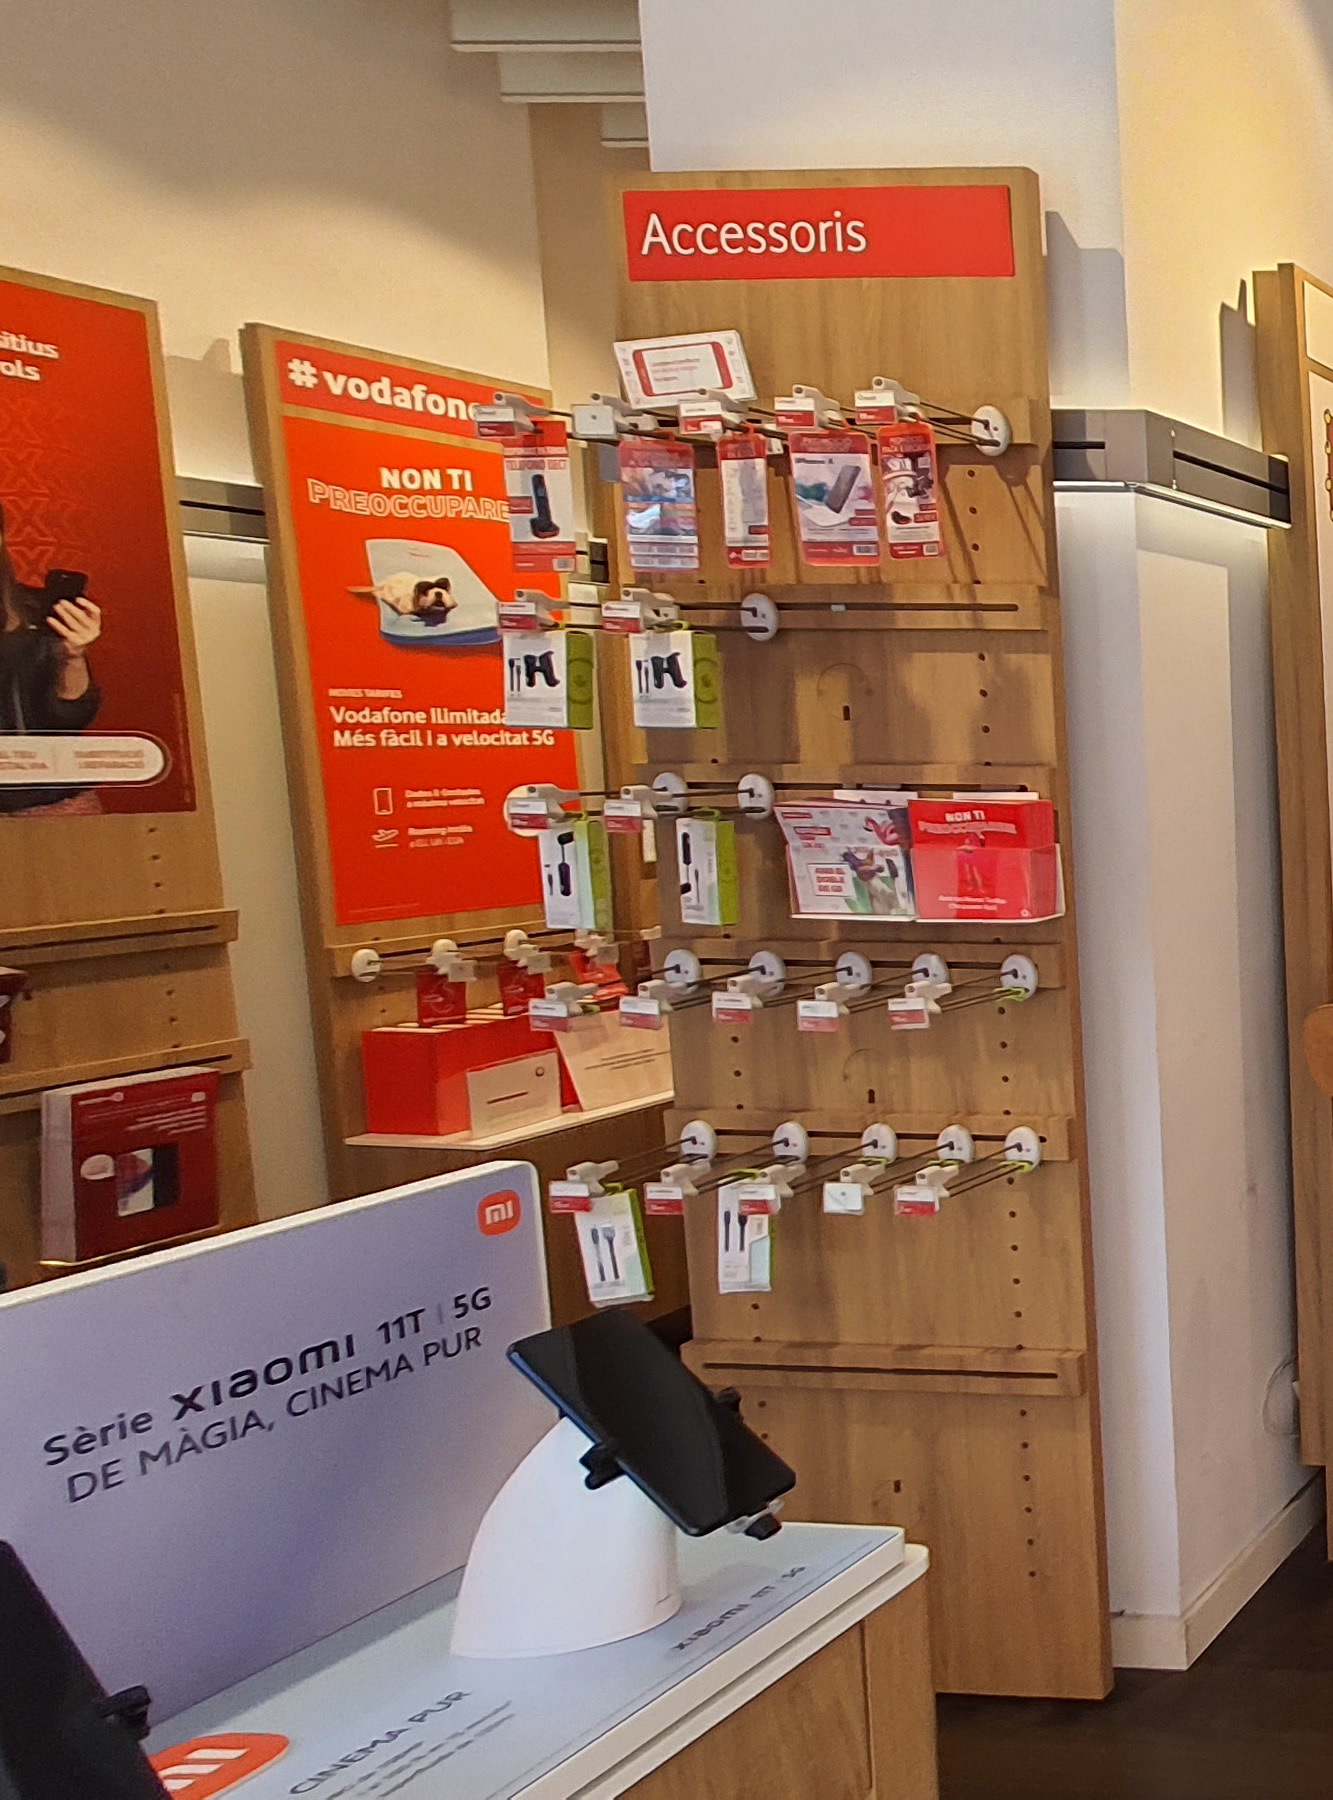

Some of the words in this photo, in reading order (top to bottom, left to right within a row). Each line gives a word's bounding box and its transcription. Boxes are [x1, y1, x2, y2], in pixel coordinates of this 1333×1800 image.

[640, 210, 867, 256] Accessoris
[380, 466, 442, 491] NON
[447, 468, 473, 492] TI
[329, 706, 427, 725] Vodafone
[333, 729, 377, 747] Més
[436, 733, 448, 747] a
[452, 729, 530, 747] velocitat
[532, 729, 555, 746] 5G
[43, 1406, 154, 1468] Sèrie
[376, 1307, 426, 1347] 11T
[453, 1286, 493, 1319] 5G
[66, 1457, 125, 1503] DE
[140, 1408, 275, 1475] MÀGIA,
[285, 1351, 414, 1419] CINEMA
[423, 1325, 482, 1368] PUR
[288, 1726, 411, 1797] CINEMA
[407, 1690, 473, 1724] PUR
